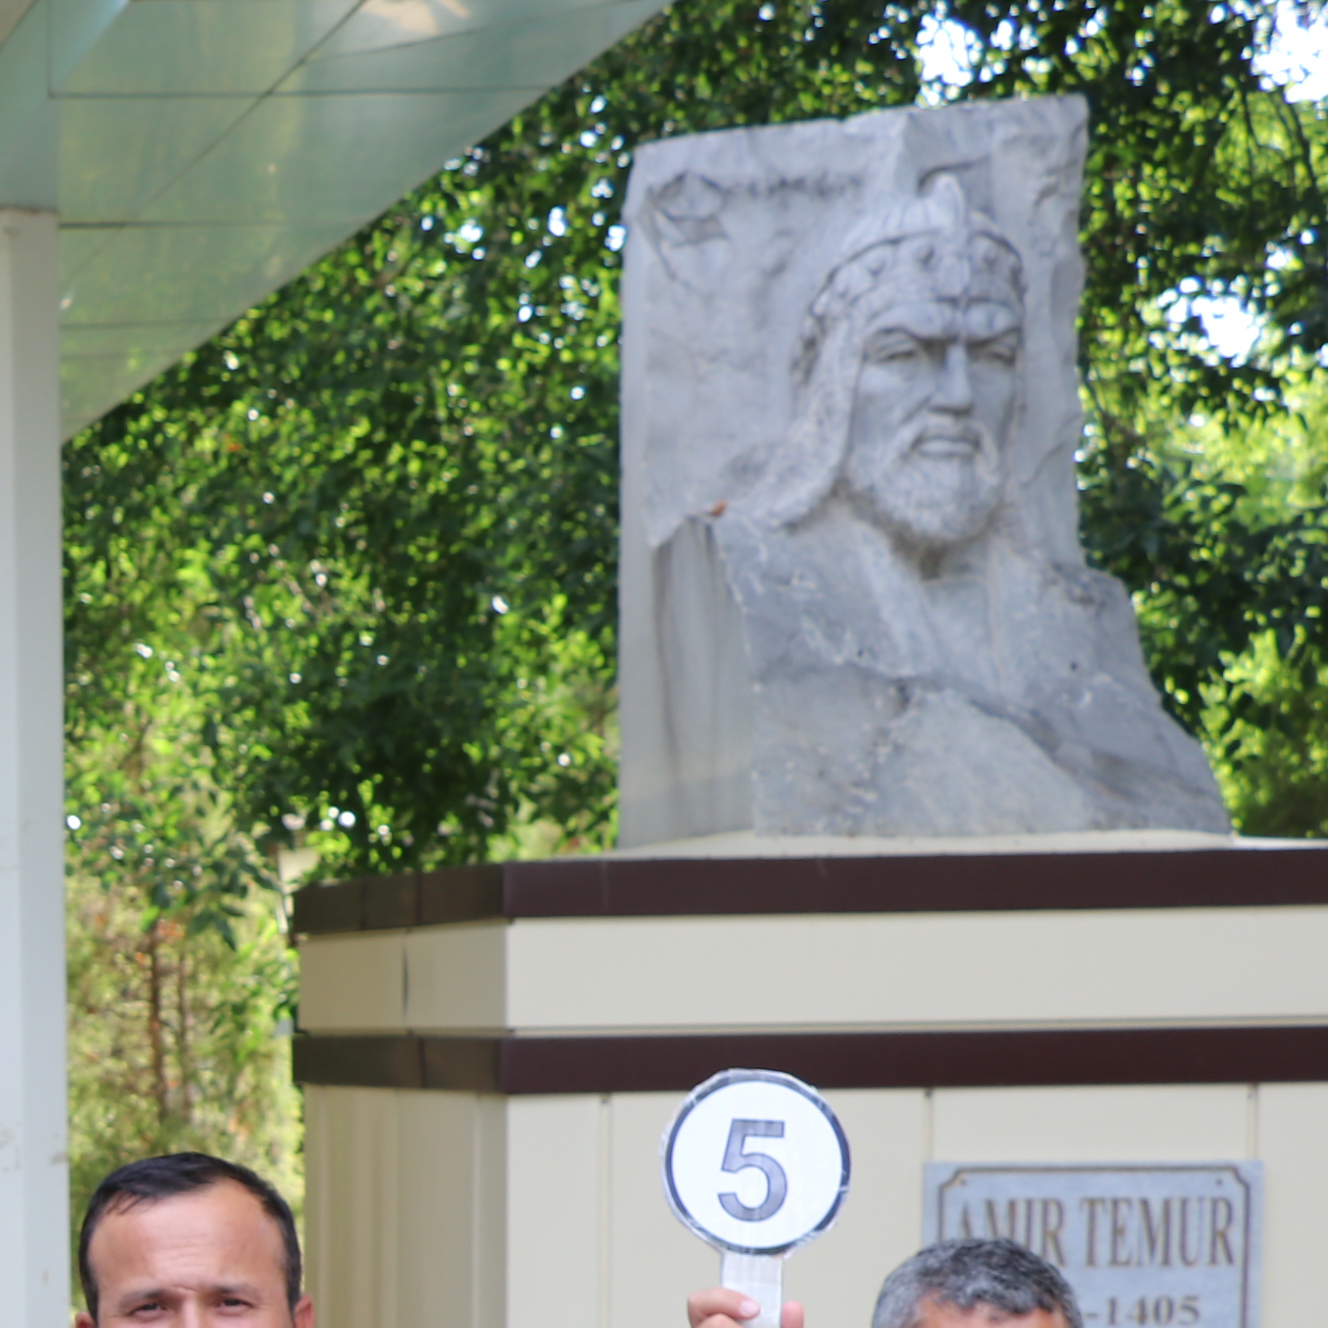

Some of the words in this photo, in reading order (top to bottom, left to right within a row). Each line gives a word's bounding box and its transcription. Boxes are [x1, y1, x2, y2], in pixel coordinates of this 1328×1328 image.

[717, 1117, 788, 1223] 5
[955, 1198, 1066, 1268] AMIR
[1079, 1197, 1235, 1268] TEMUR
